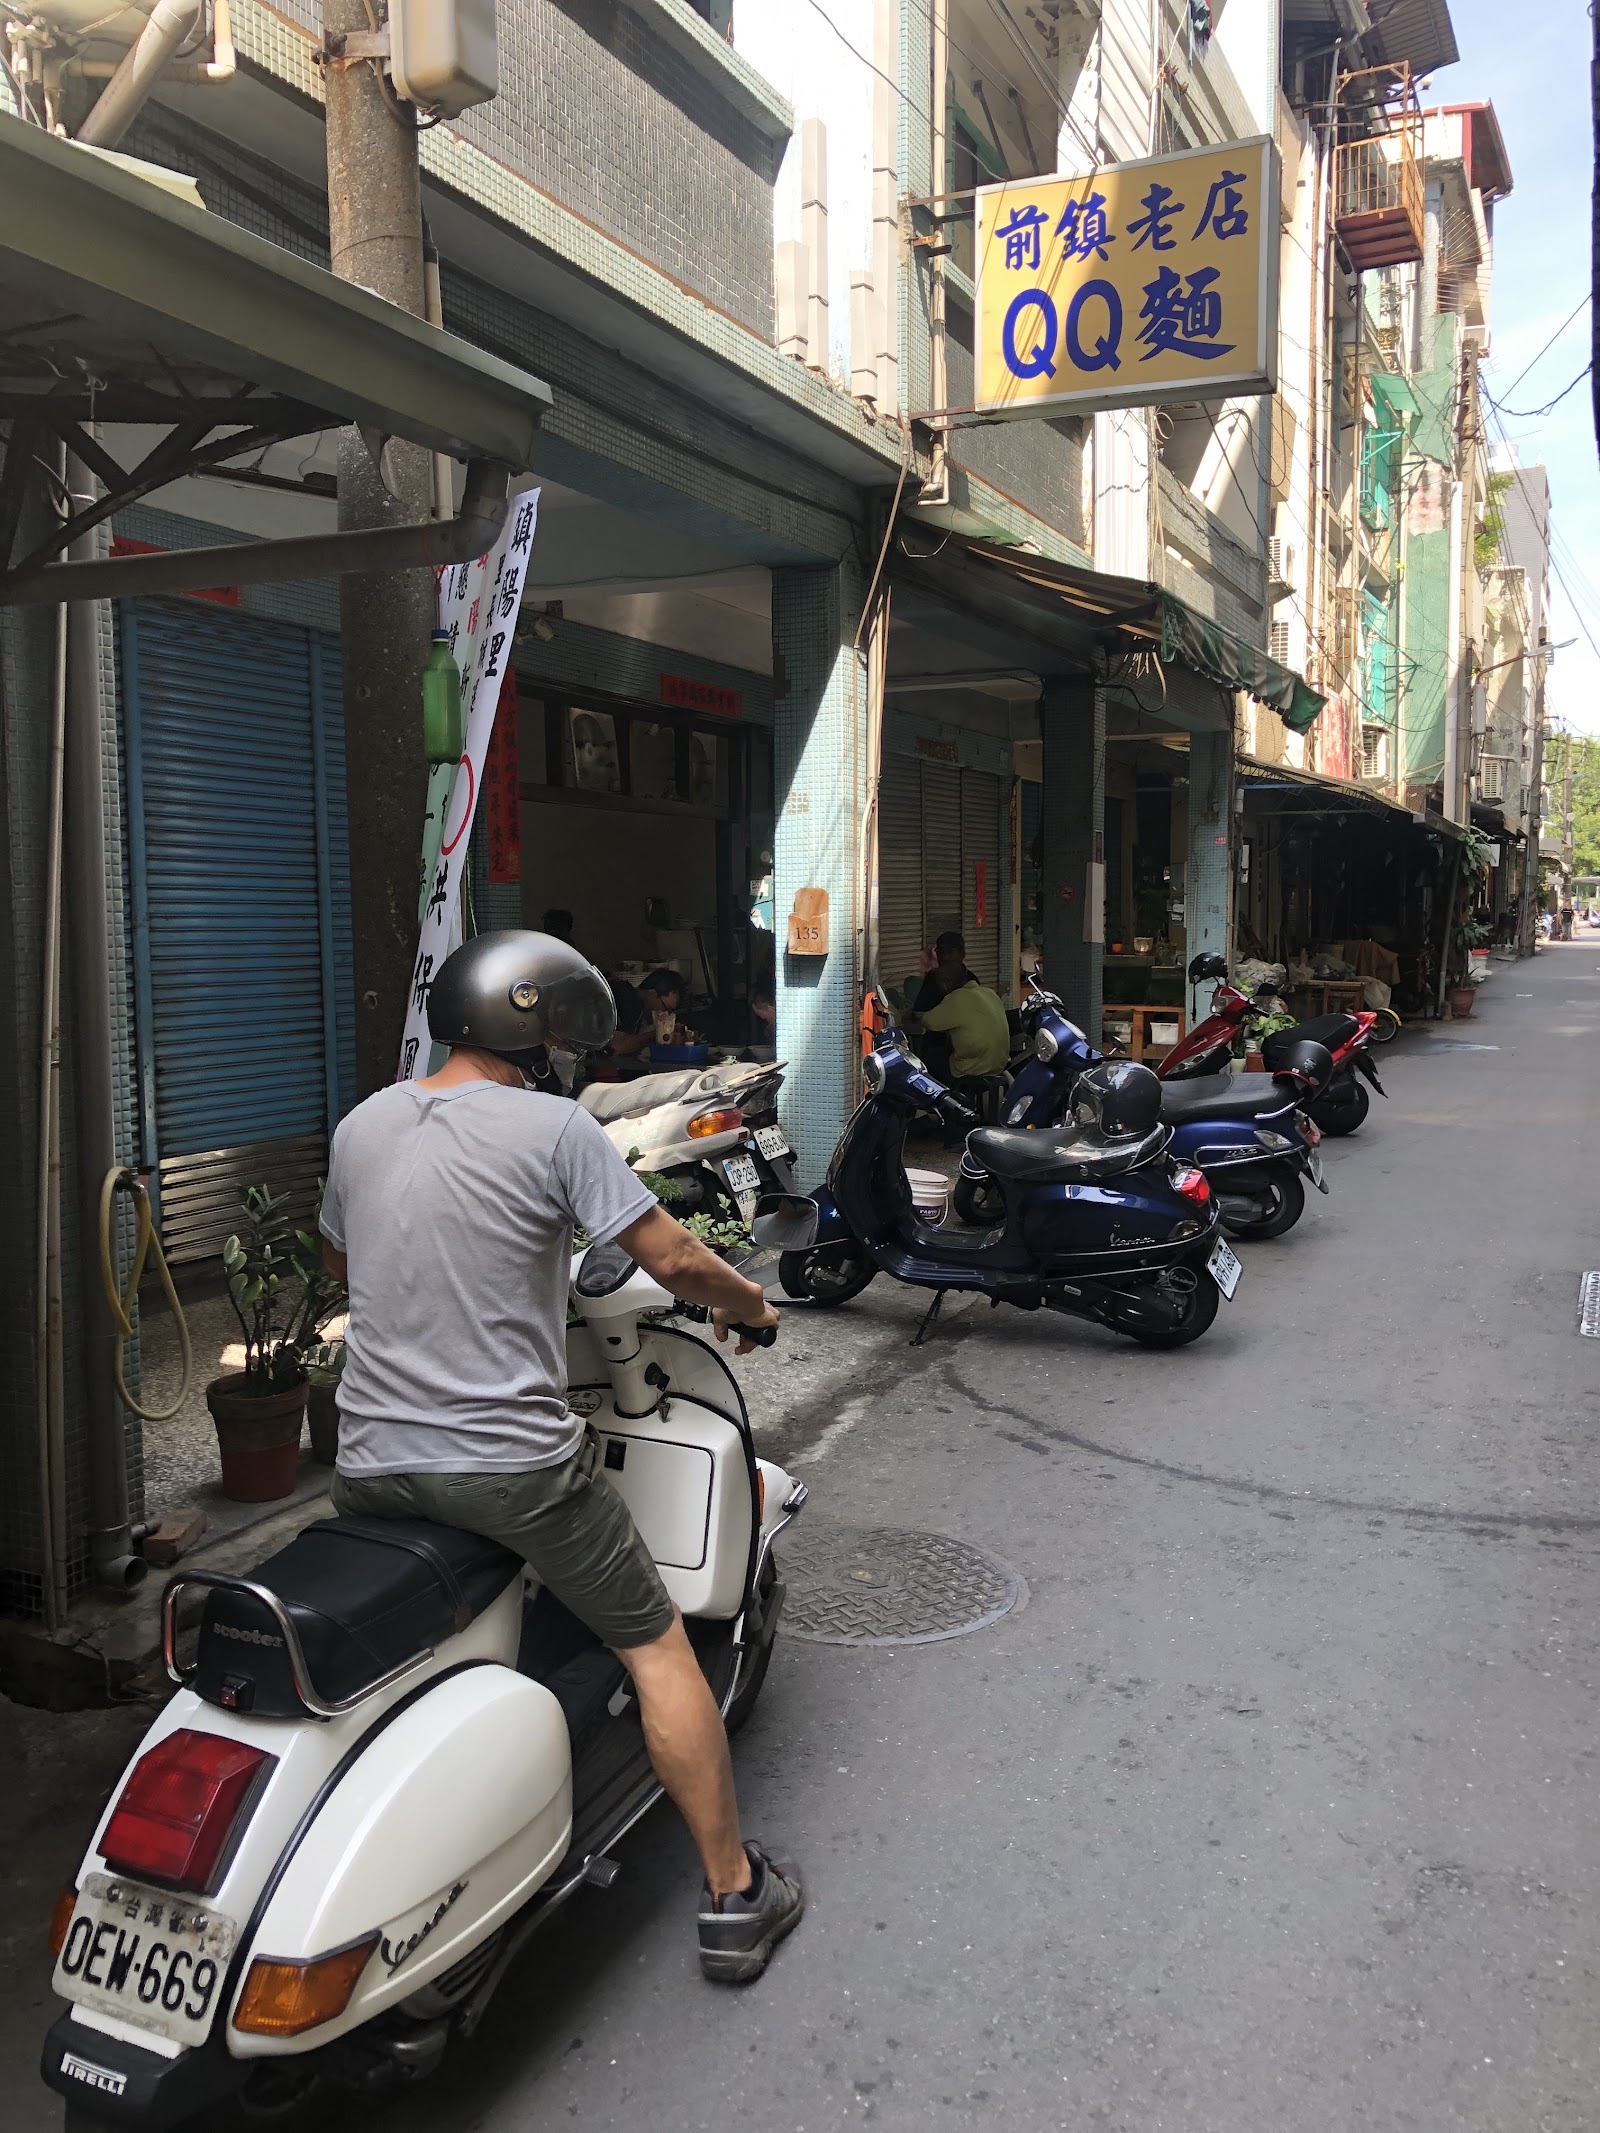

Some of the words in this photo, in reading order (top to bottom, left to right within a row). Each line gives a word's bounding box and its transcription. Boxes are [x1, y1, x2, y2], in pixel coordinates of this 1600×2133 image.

[995, 170, 1249, 271] 前鎮老店
[1002, 265, 1237, 380] QQ麵
[484, 501, 534, 678] 鎮陽里
[796, 927, 819, 940] 135
[213, 1622, 284, 1648] scooter
[61, 1916, 219, 2021] OEW-669
[60, 2052, 127, 2096] PIRELLI
